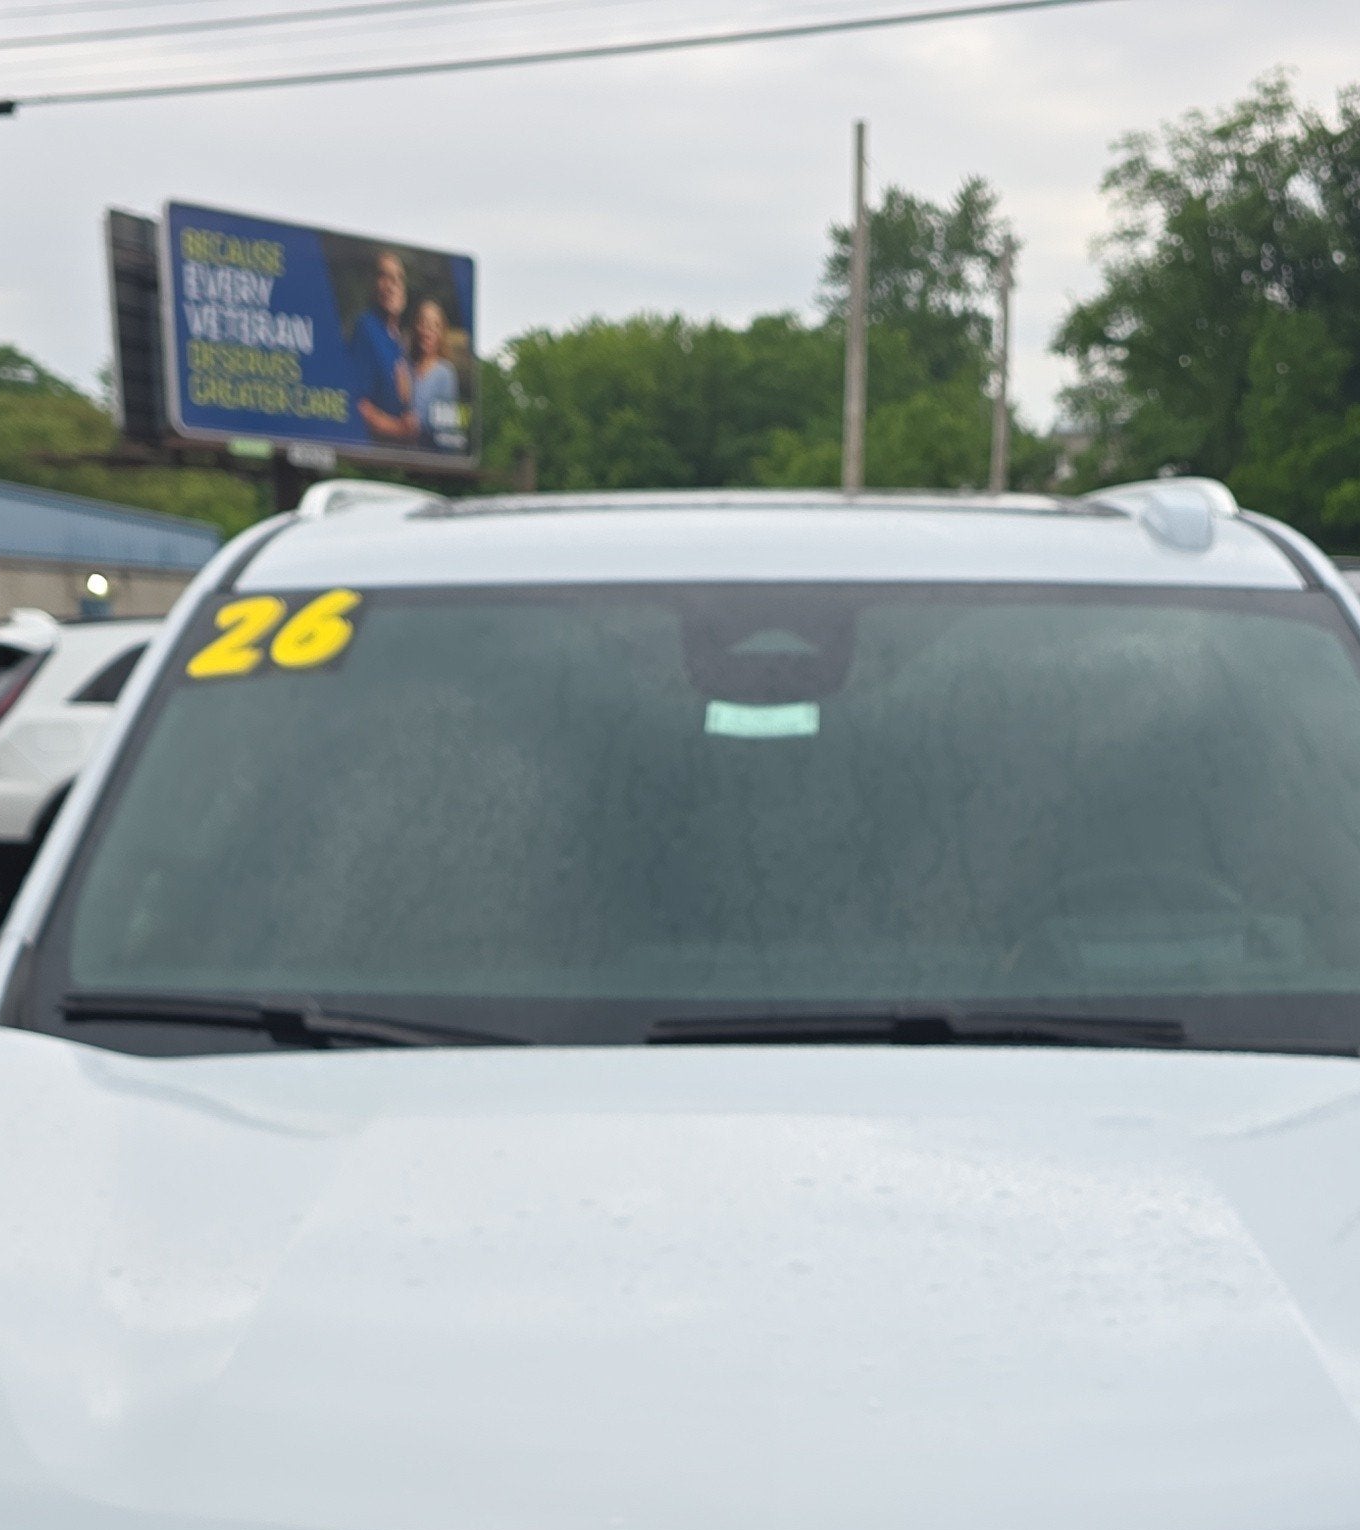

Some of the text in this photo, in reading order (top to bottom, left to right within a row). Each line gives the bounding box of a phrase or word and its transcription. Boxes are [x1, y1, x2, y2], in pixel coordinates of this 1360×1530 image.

[183, 261, 275, 307] EVERY
[184, 303, 314, 354] VETERAN
[186, 588, 362, 678] 26
